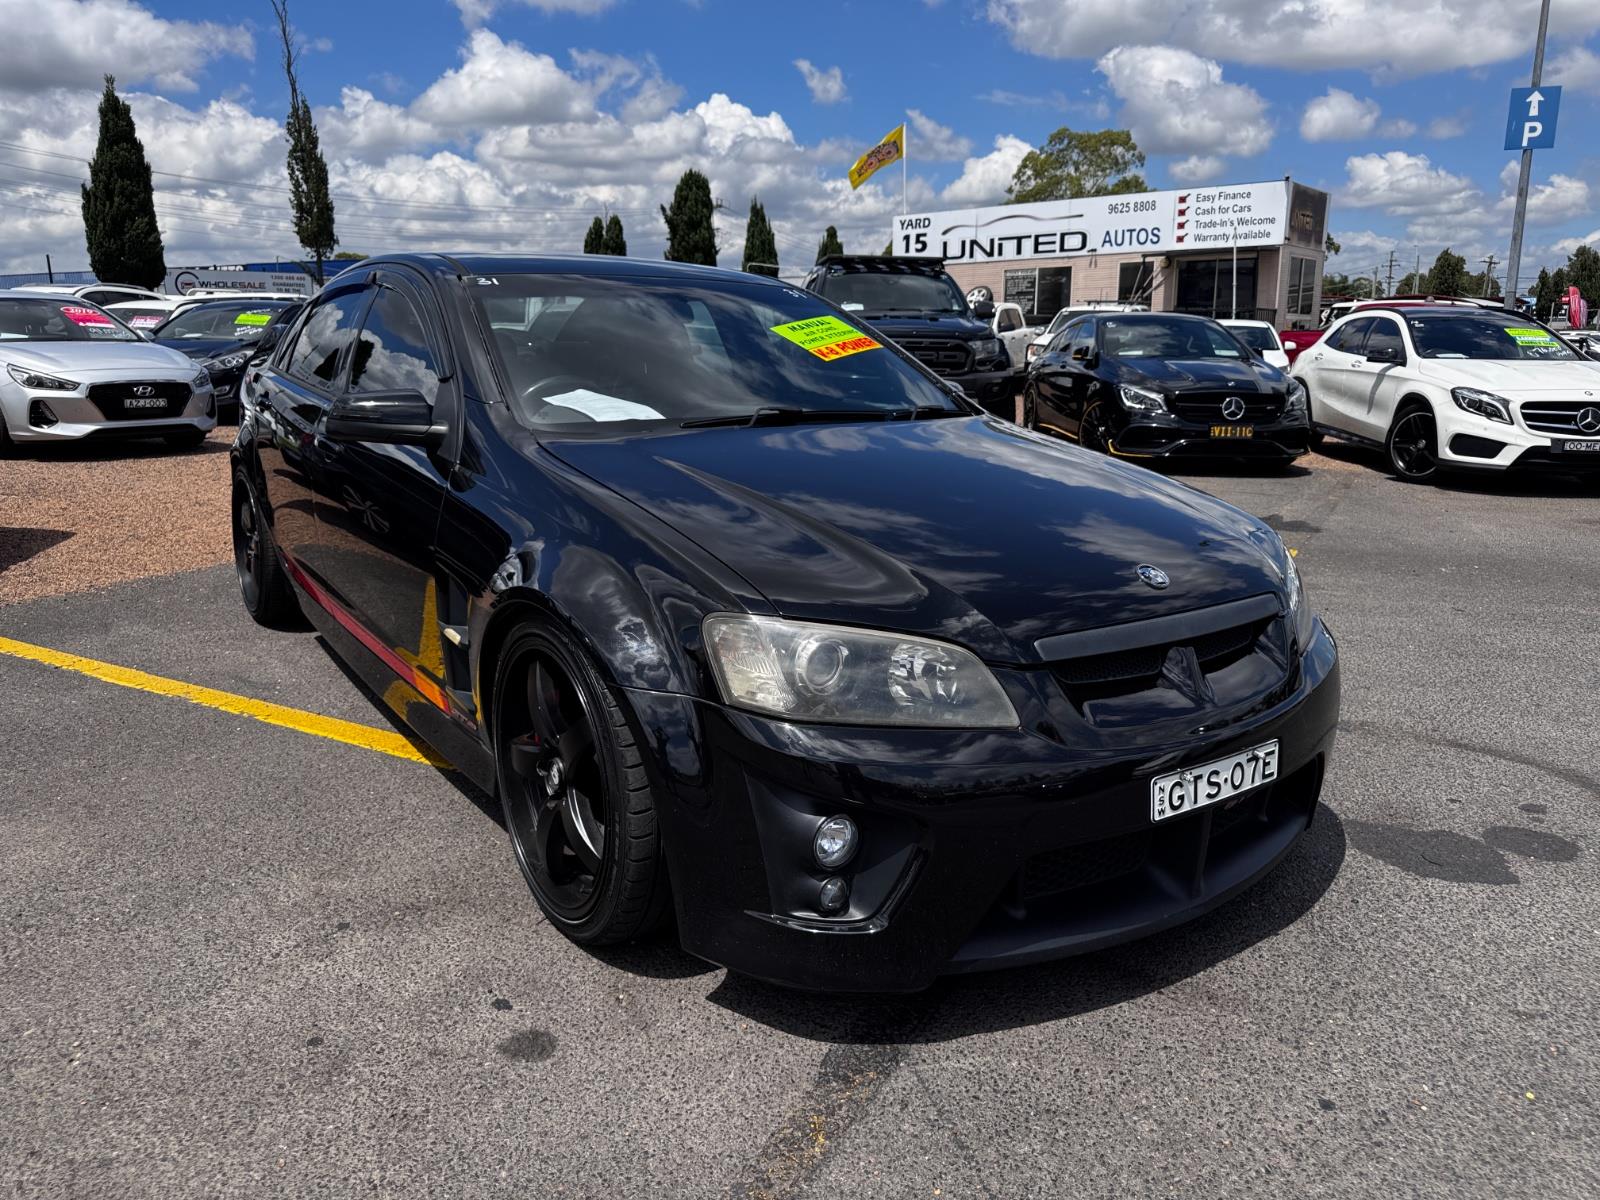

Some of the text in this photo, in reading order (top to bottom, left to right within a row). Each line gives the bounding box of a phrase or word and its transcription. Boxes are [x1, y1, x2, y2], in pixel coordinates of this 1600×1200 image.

[1522, 121, 1542, 147] P
[1196, 191, 1251, 203] Easy Finance
[1108, 200, 1156, 214] 9625 8808
[1195, 204, 1252, 216] Cash for Cars
[899, 217, 931, 230] YARD
[1195, 216, 1276, 229] Trade-In's Welcome
[1101, 227, 1161, 248] AUTOS
[1193, 230, 1271, 243] Warranty Available
[902, 233, 928, 254] 15
[198, 280, 267, 289] WHOLESALE
[476, 277, 500, 286] 31
[787, 319, 832, 332] MANUAL
[799, 336, 826, 345] POWER
[835, 337, 876, 352] POWER
